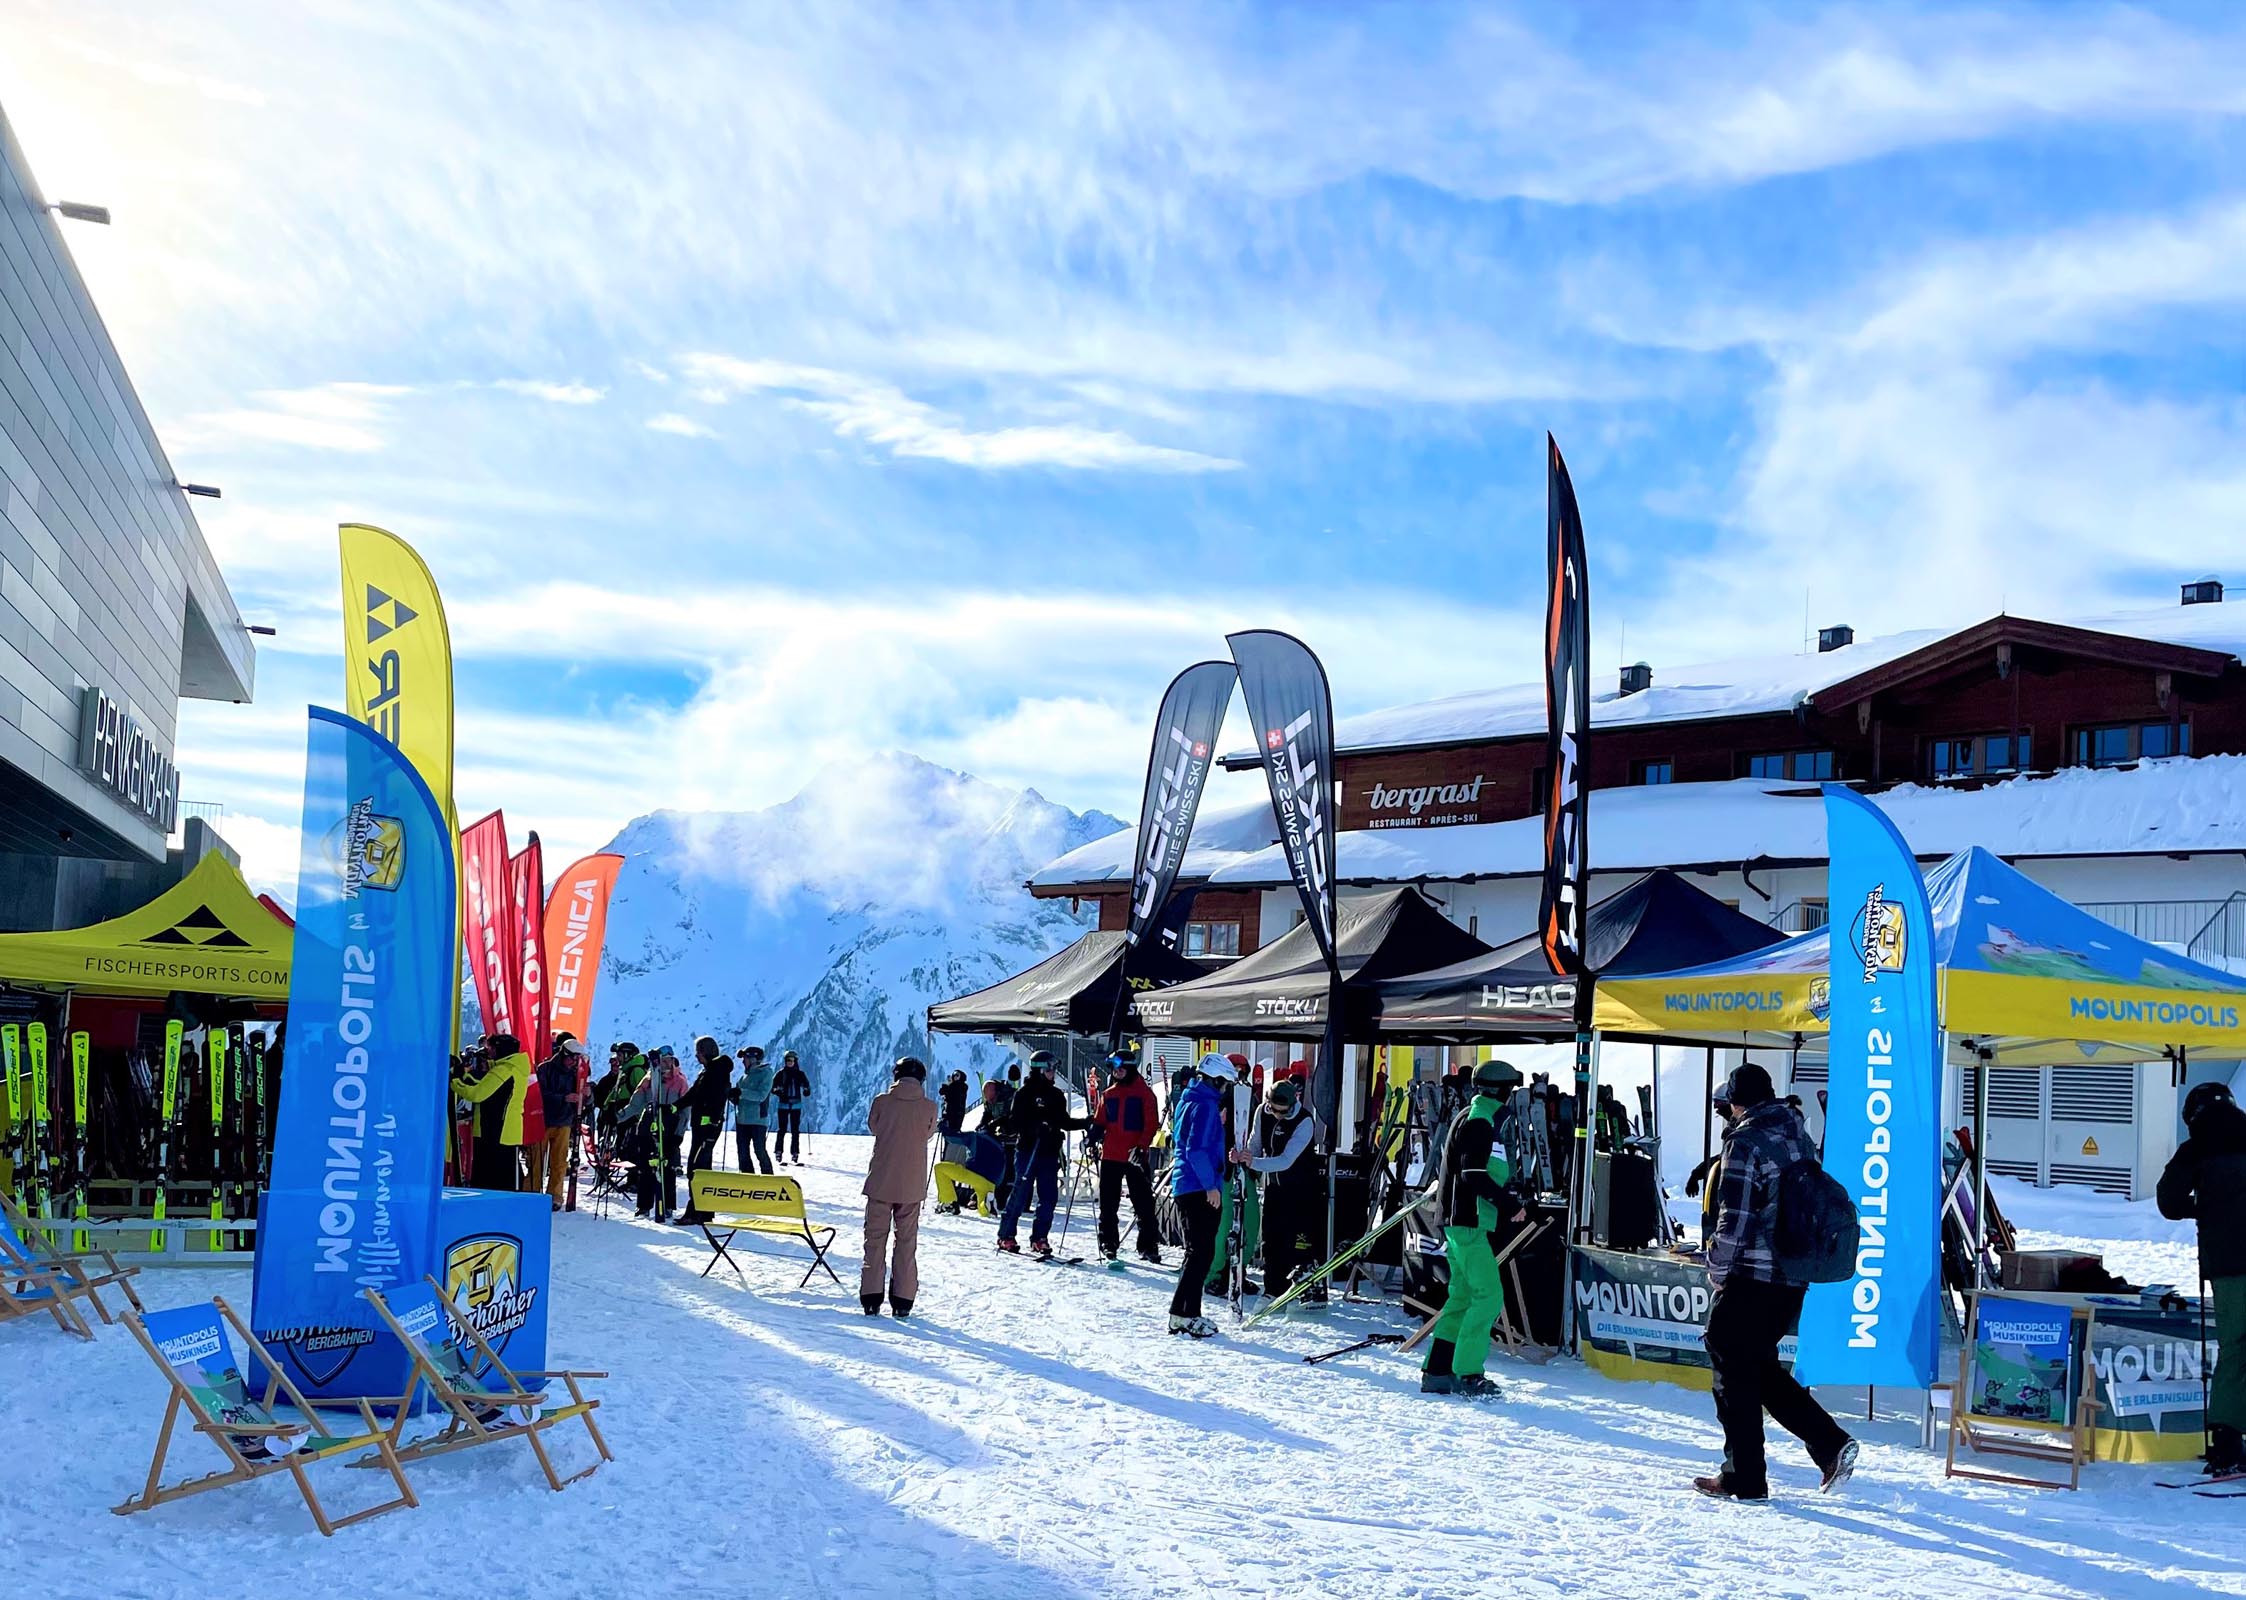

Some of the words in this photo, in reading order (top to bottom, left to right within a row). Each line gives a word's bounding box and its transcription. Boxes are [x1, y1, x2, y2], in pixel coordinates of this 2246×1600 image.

[92, 687, 179, 832] PENKENBAHN
[1362, 775, 1496, 815] bergrast
[1165, 839, 1181, 872] THE
[1174, 791, 1195, 838] SWISS
[1187, 759, 1202, 787] SKI
[1369, 817, 1422, 829] RESTAURANT
[551, 879, 598, 1021] TECNICA
[84, 956, 288, 985] FISCHERSPORTS.COM
[1127, 1000, 1175, 1016] STÖCKLI
[1255, 996, 1319, 1015] STÖCKLI
[1481, 984, 1577, 1008] HEAD
[1664, 991, 1783, 1012] MOUNTOPOLIS
[2070, 997, 2239, 1028] MOUNTOPOLIS
[37, 1049, 46, 1104] FISCHER
[234, 1047, 242, 1101] FISCHER
[702, 1187, 776, 1200] FISCHER
[445, 1287, 537, 1345] ayrhofner
[1984, 1320, 2063, 1331] MOUNTOPOLIS
[158, 1326, 218, 1352] MOUNTOPOLIS
[307, 1329, 374, 1351] BERGBAHNEN
[1993, 1331, 2057, 1342] MUSIKINSEL
[168, 1340, 218, 1363] MUSIKINSEL
[2134, 1390, 2207, 1405] ERLEBNISWEL
